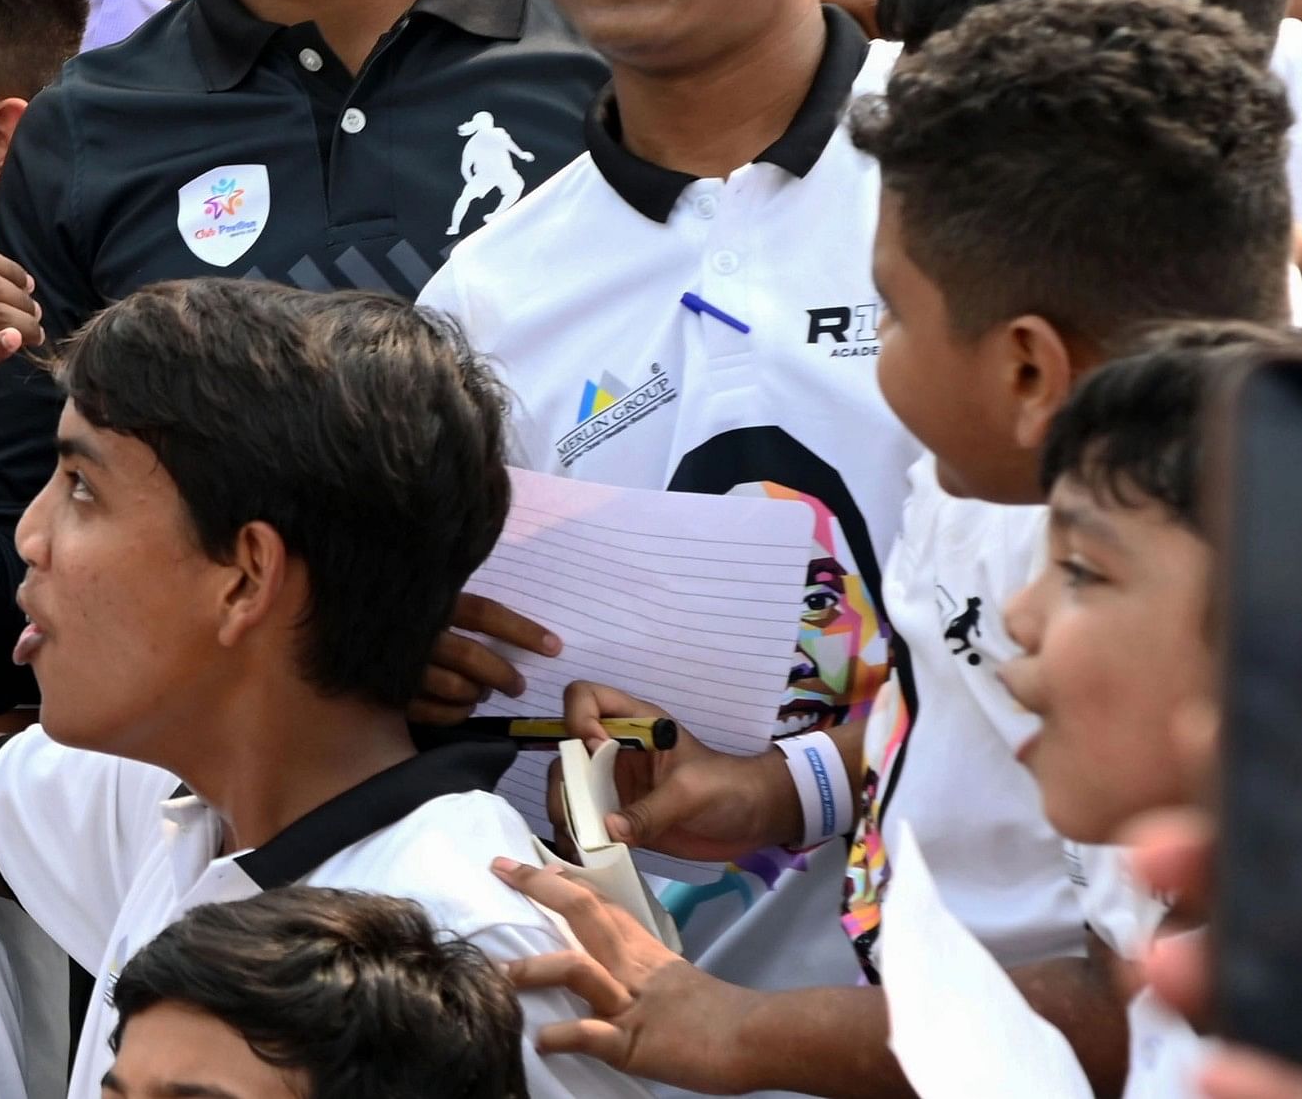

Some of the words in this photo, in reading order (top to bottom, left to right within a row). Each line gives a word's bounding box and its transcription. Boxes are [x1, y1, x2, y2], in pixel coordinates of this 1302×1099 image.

[805, 304, 880, 344] R1
[830, 345, 882, 358] ACADE
[557, 415, 610, 459] MERLIN
[611, 377, 670, 421] GROUP
